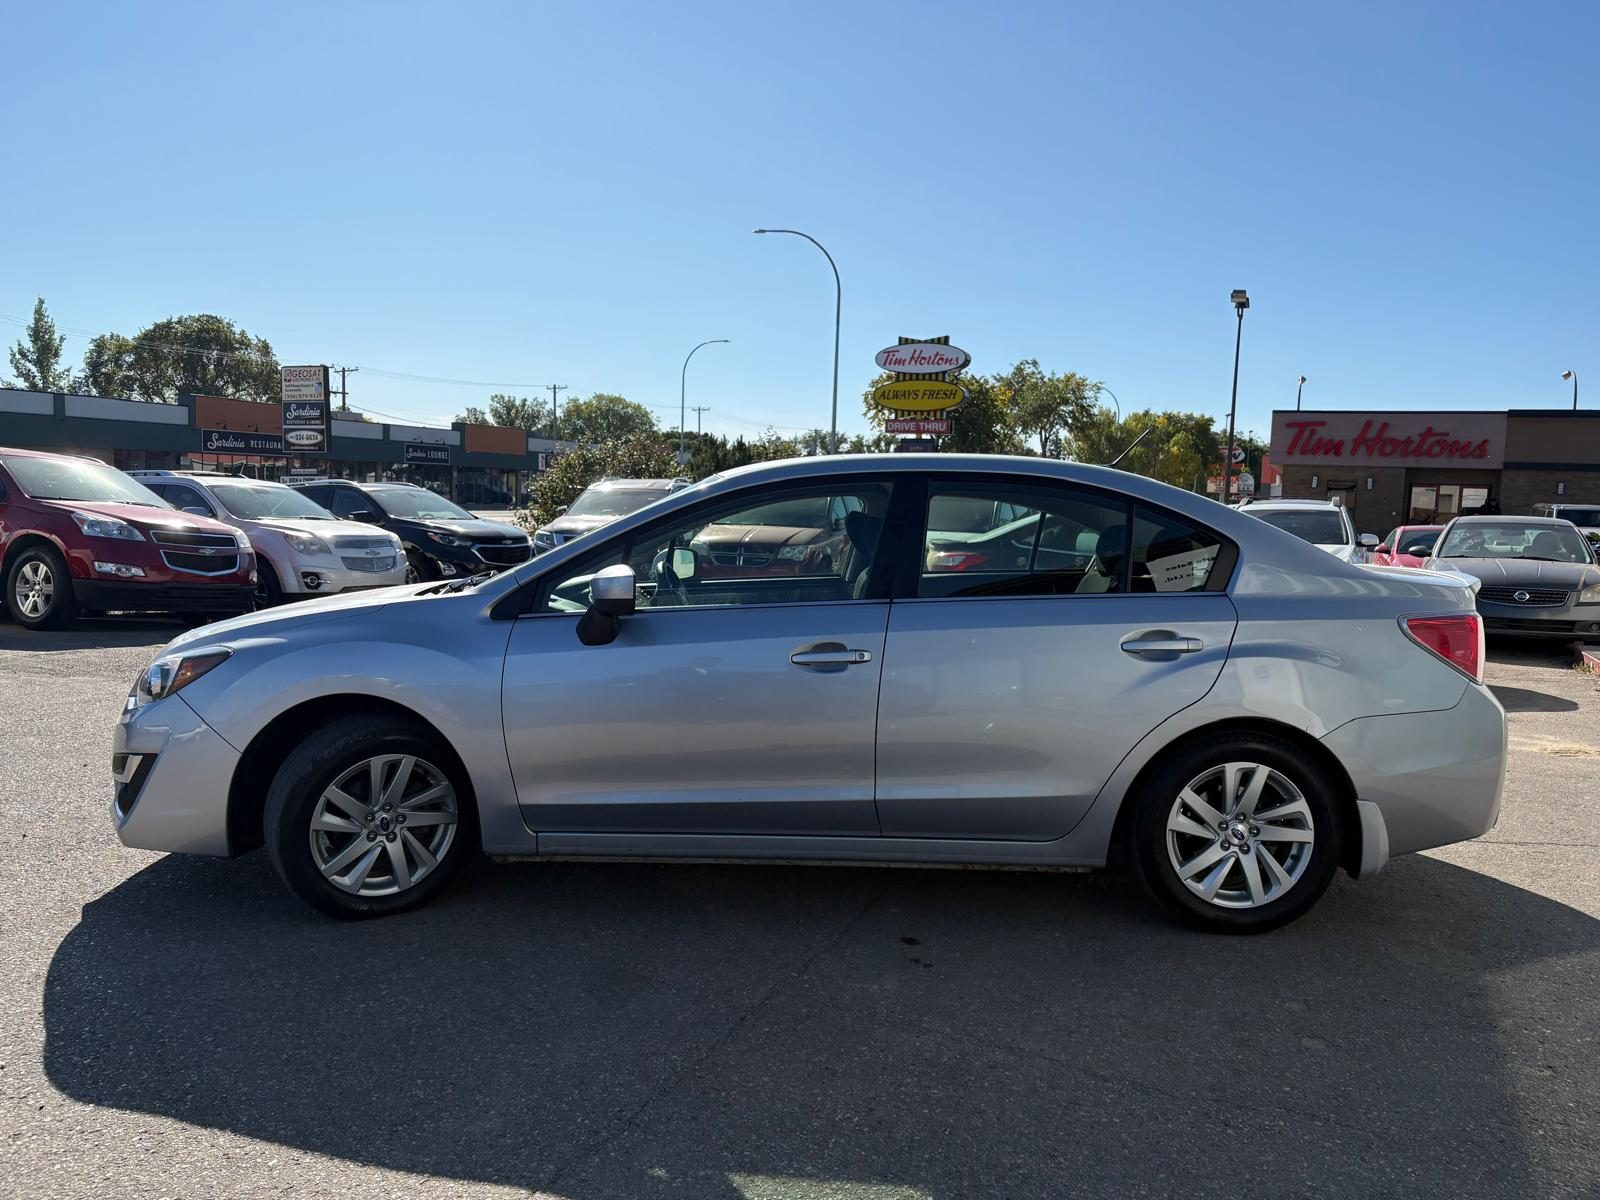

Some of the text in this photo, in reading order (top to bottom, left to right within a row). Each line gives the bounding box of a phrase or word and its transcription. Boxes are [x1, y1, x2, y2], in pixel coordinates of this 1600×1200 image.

[883, 349, 959, 366] Tim Hortons
[291, 369, 321, 378] GEOSAT
[880, 389, 958, 400] ALWAYS FRESH
[286, 403, 321, 419] Sardinia
[887, 422, 946, 431] DRIVE THRU
[207, 432, 282, 449] Sardinia RESTAURA
[1285, 419, 1489, 460] Tim Hortons
[427, 450, 449, 460] LOUNGE
